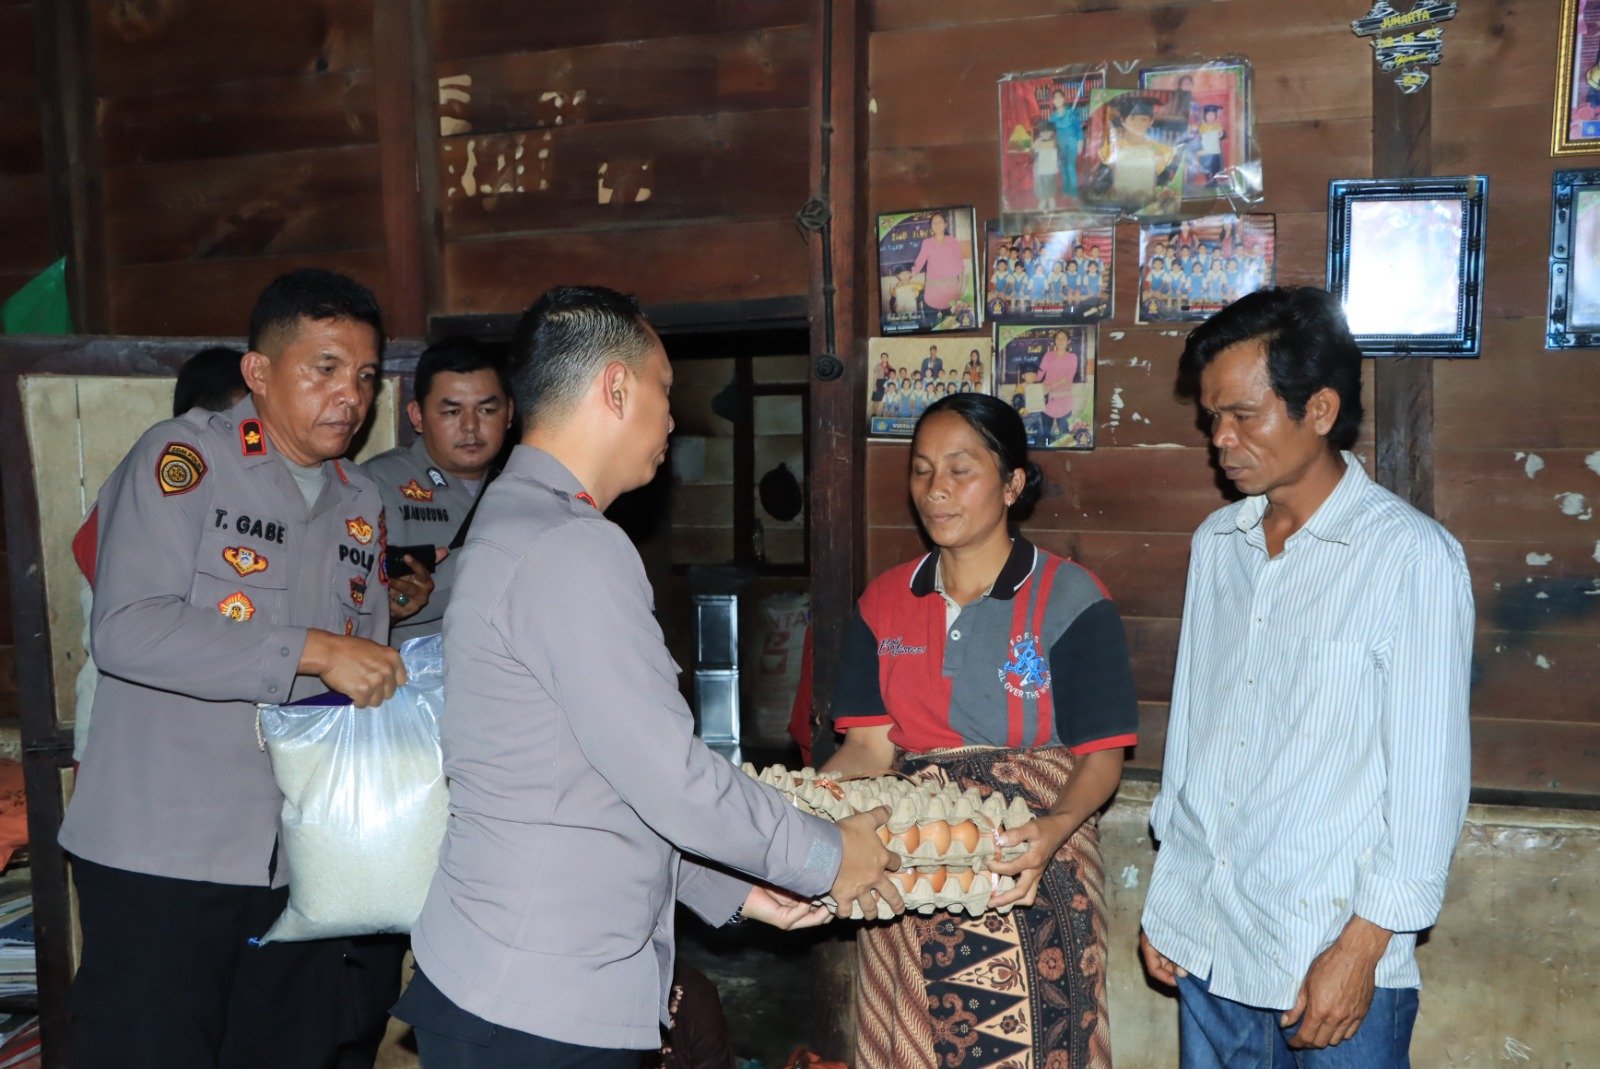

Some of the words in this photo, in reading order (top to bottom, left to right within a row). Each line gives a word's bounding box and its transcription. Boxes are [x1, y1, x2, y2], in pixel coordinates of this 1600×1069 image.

[215, 509, 228, 530] T.
[236, 515, 286, 544] GABE
[1004, 682, 1024, 698] OVER
[1025, 690, 1041, 699] THE
